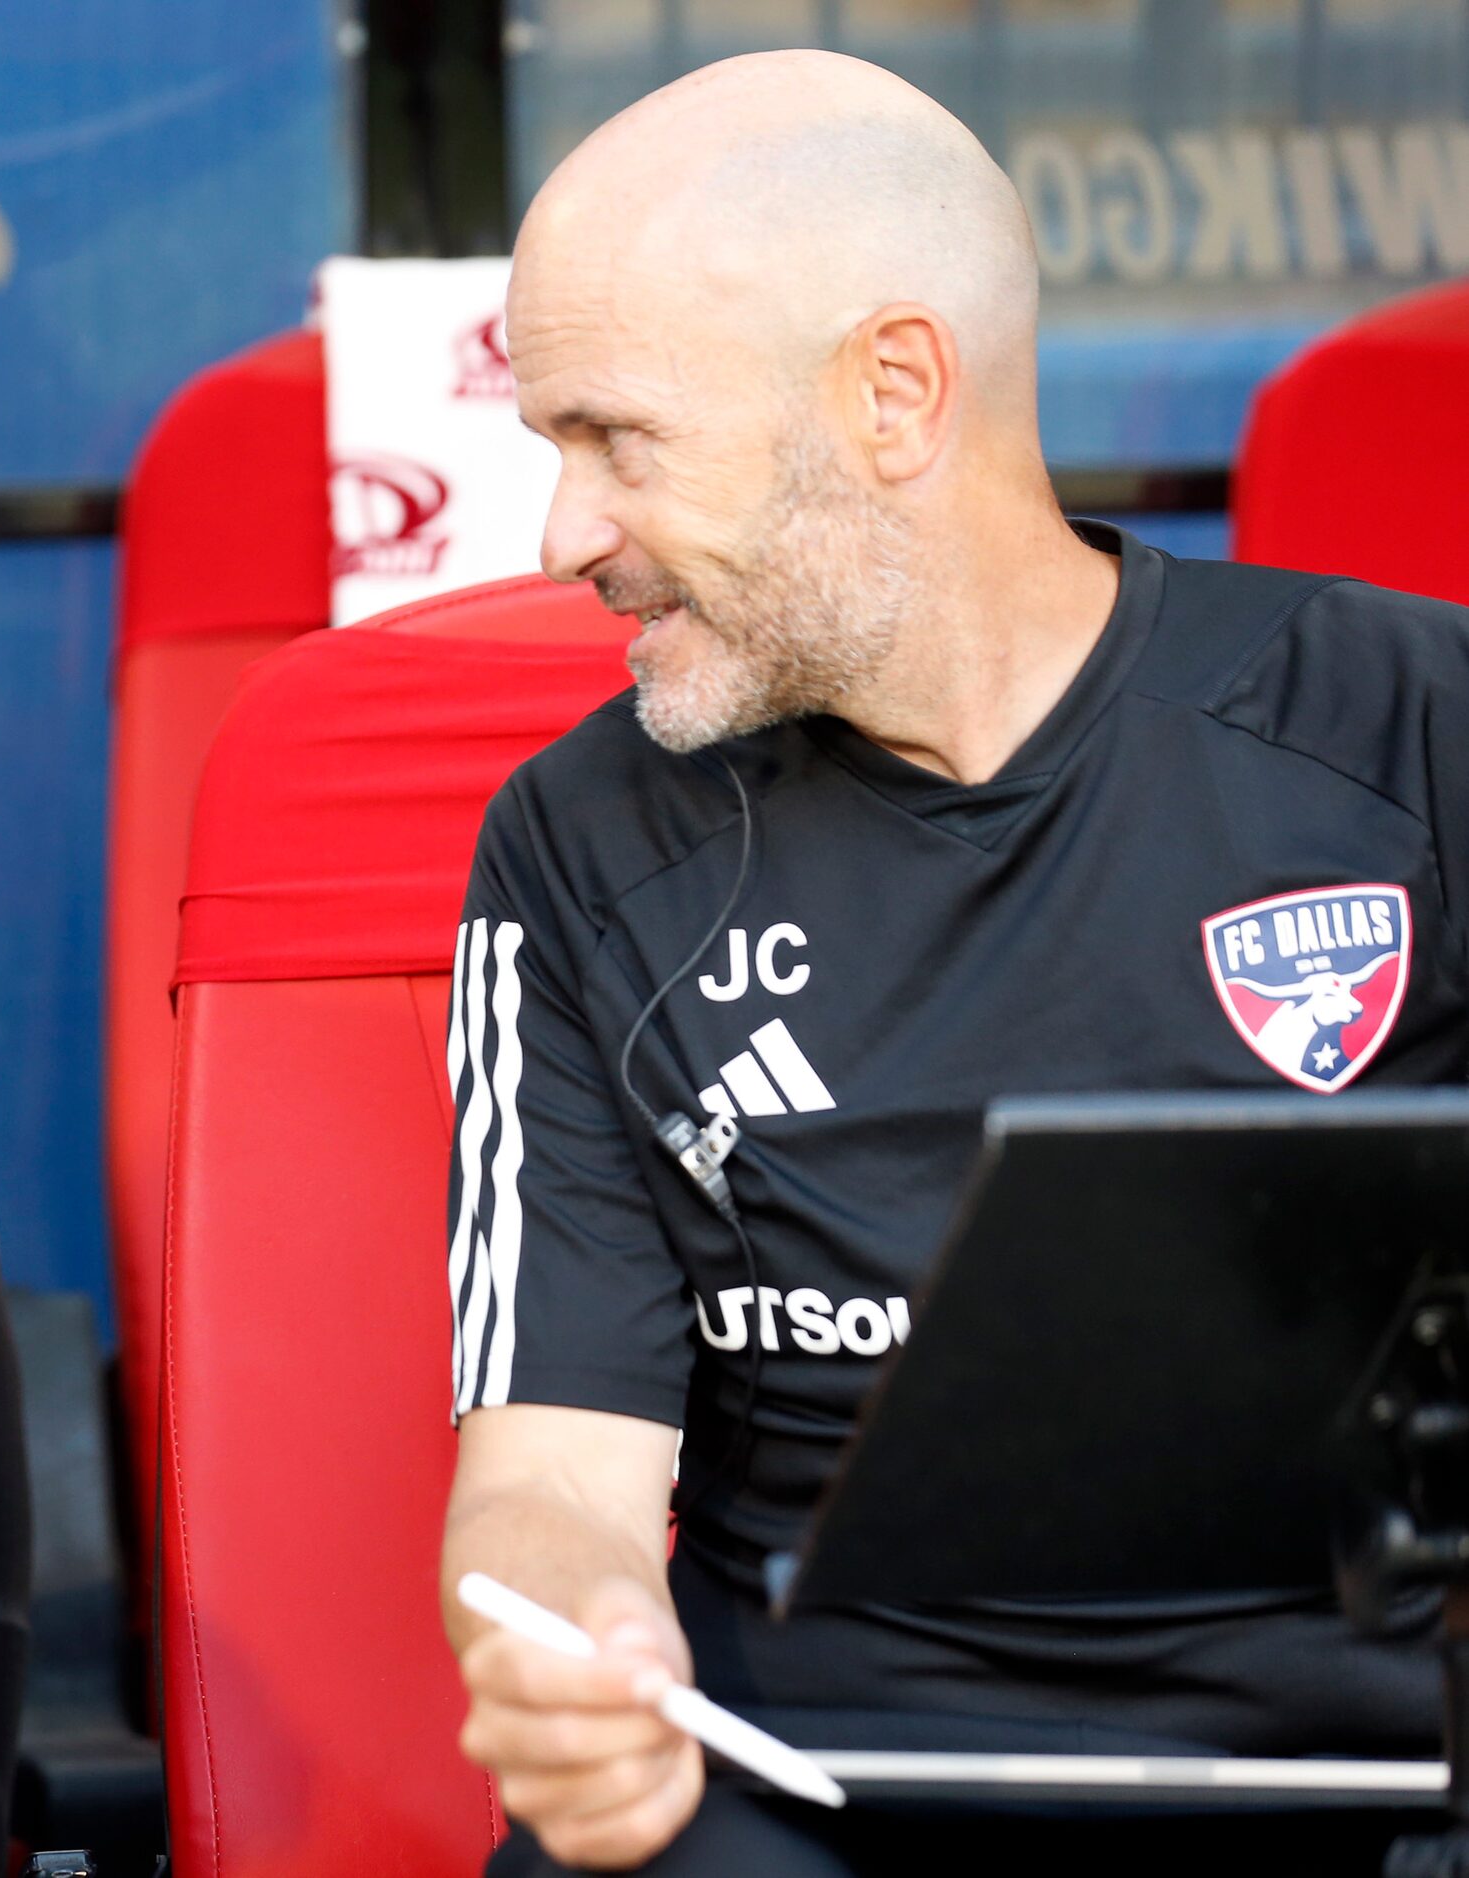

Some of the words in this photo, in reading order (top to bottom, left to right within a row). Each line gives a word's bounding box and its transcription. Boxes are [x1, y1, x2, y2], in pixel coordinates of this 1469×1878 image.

[698, 922, 811, 1002] JC
[1224, 919, 1265, 972] FC
[1273, 900, 1394, 958] DALLAS
